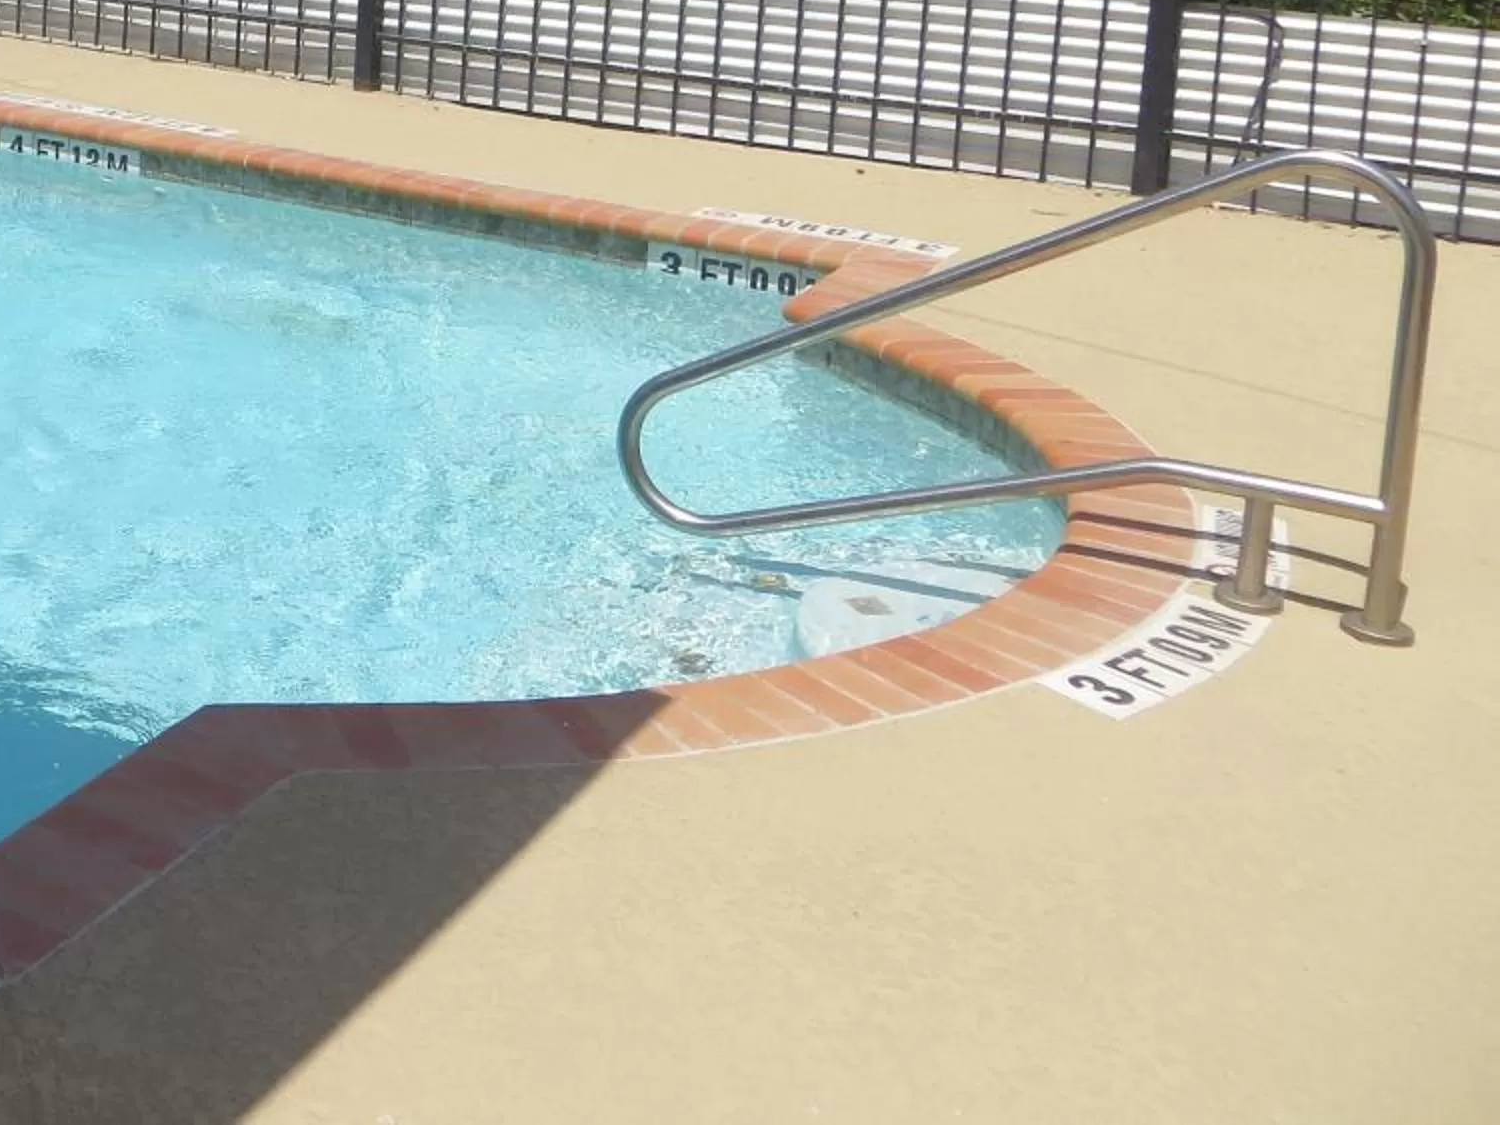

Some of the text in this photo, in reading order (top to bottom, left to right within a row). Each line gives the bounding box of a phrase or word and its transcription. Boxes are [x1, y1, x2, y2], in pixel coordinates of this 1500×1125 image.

[9, 135, 23, 153] 4
[660, 251, 682, 275] 3
[1067, 674, 1136, 706] 3
